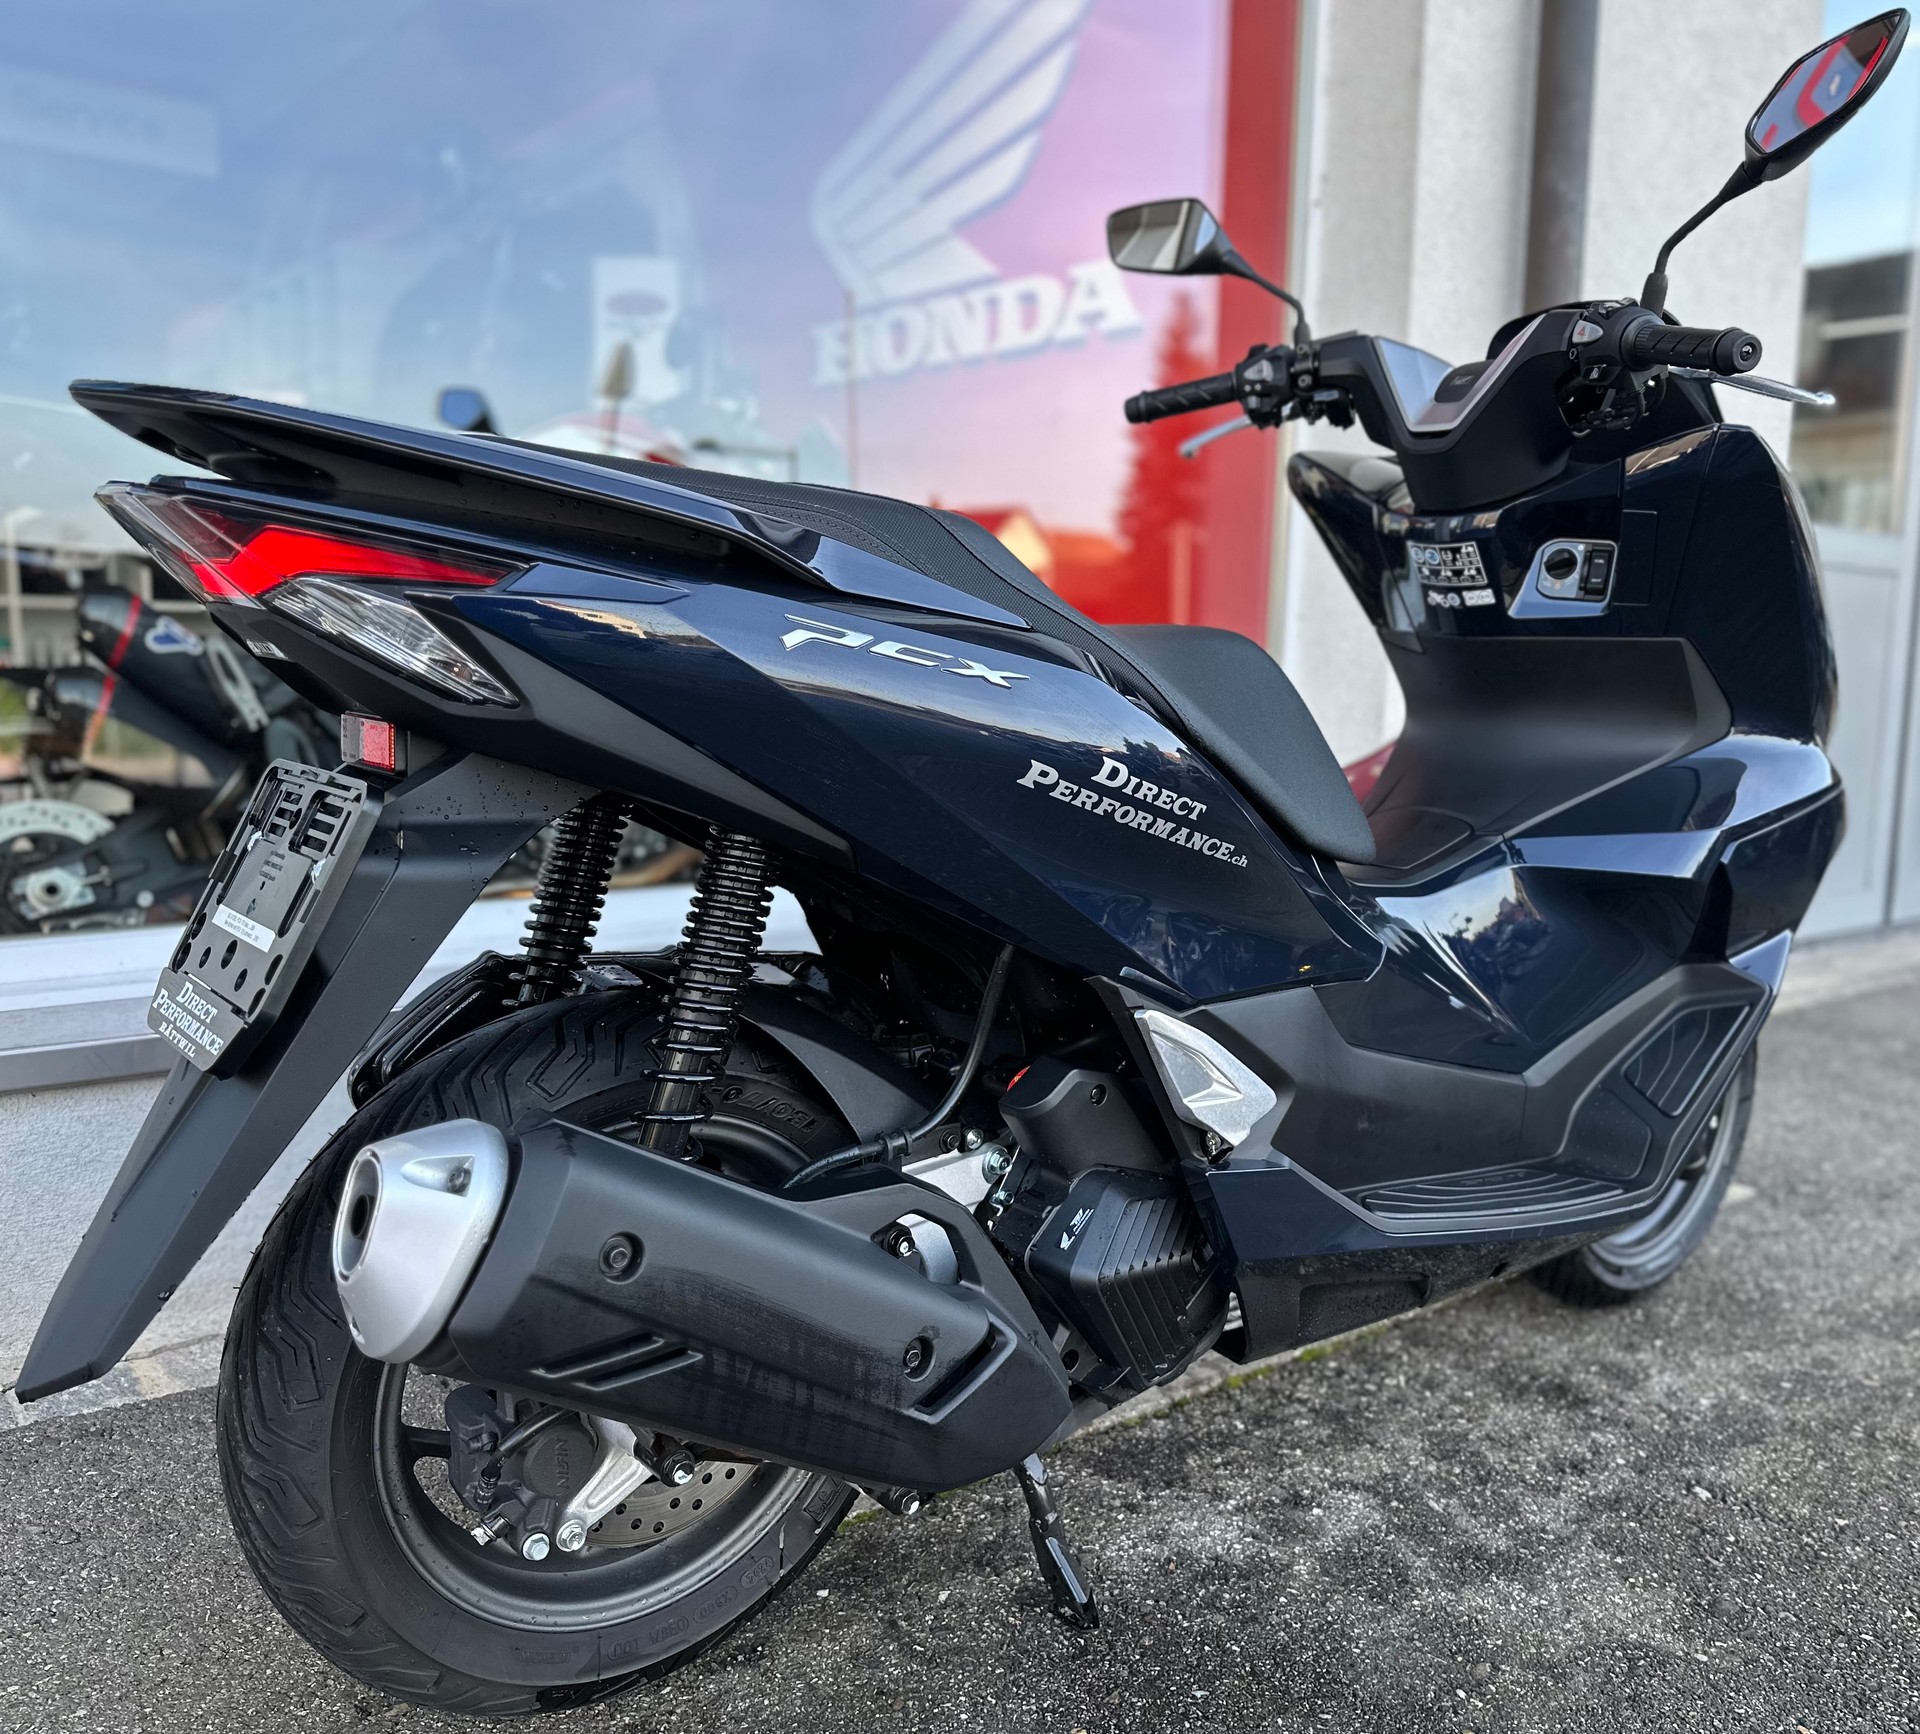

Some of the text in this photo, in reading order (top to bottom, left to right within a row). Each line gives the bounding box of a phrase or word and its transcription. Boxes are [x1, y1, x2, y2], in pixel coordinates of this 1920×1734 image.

[812, 258, 1143, 384] HONDA
[779, 613, 1031, 690] PCX
[1016, 759, 1248, 868] PERFORMANCE.ch
[1091, 756, 1207, 821] DIRECT
[152, 988, 224, 1056] PERFORMANCE
[176, 981, 218, 1024] DIRECT
